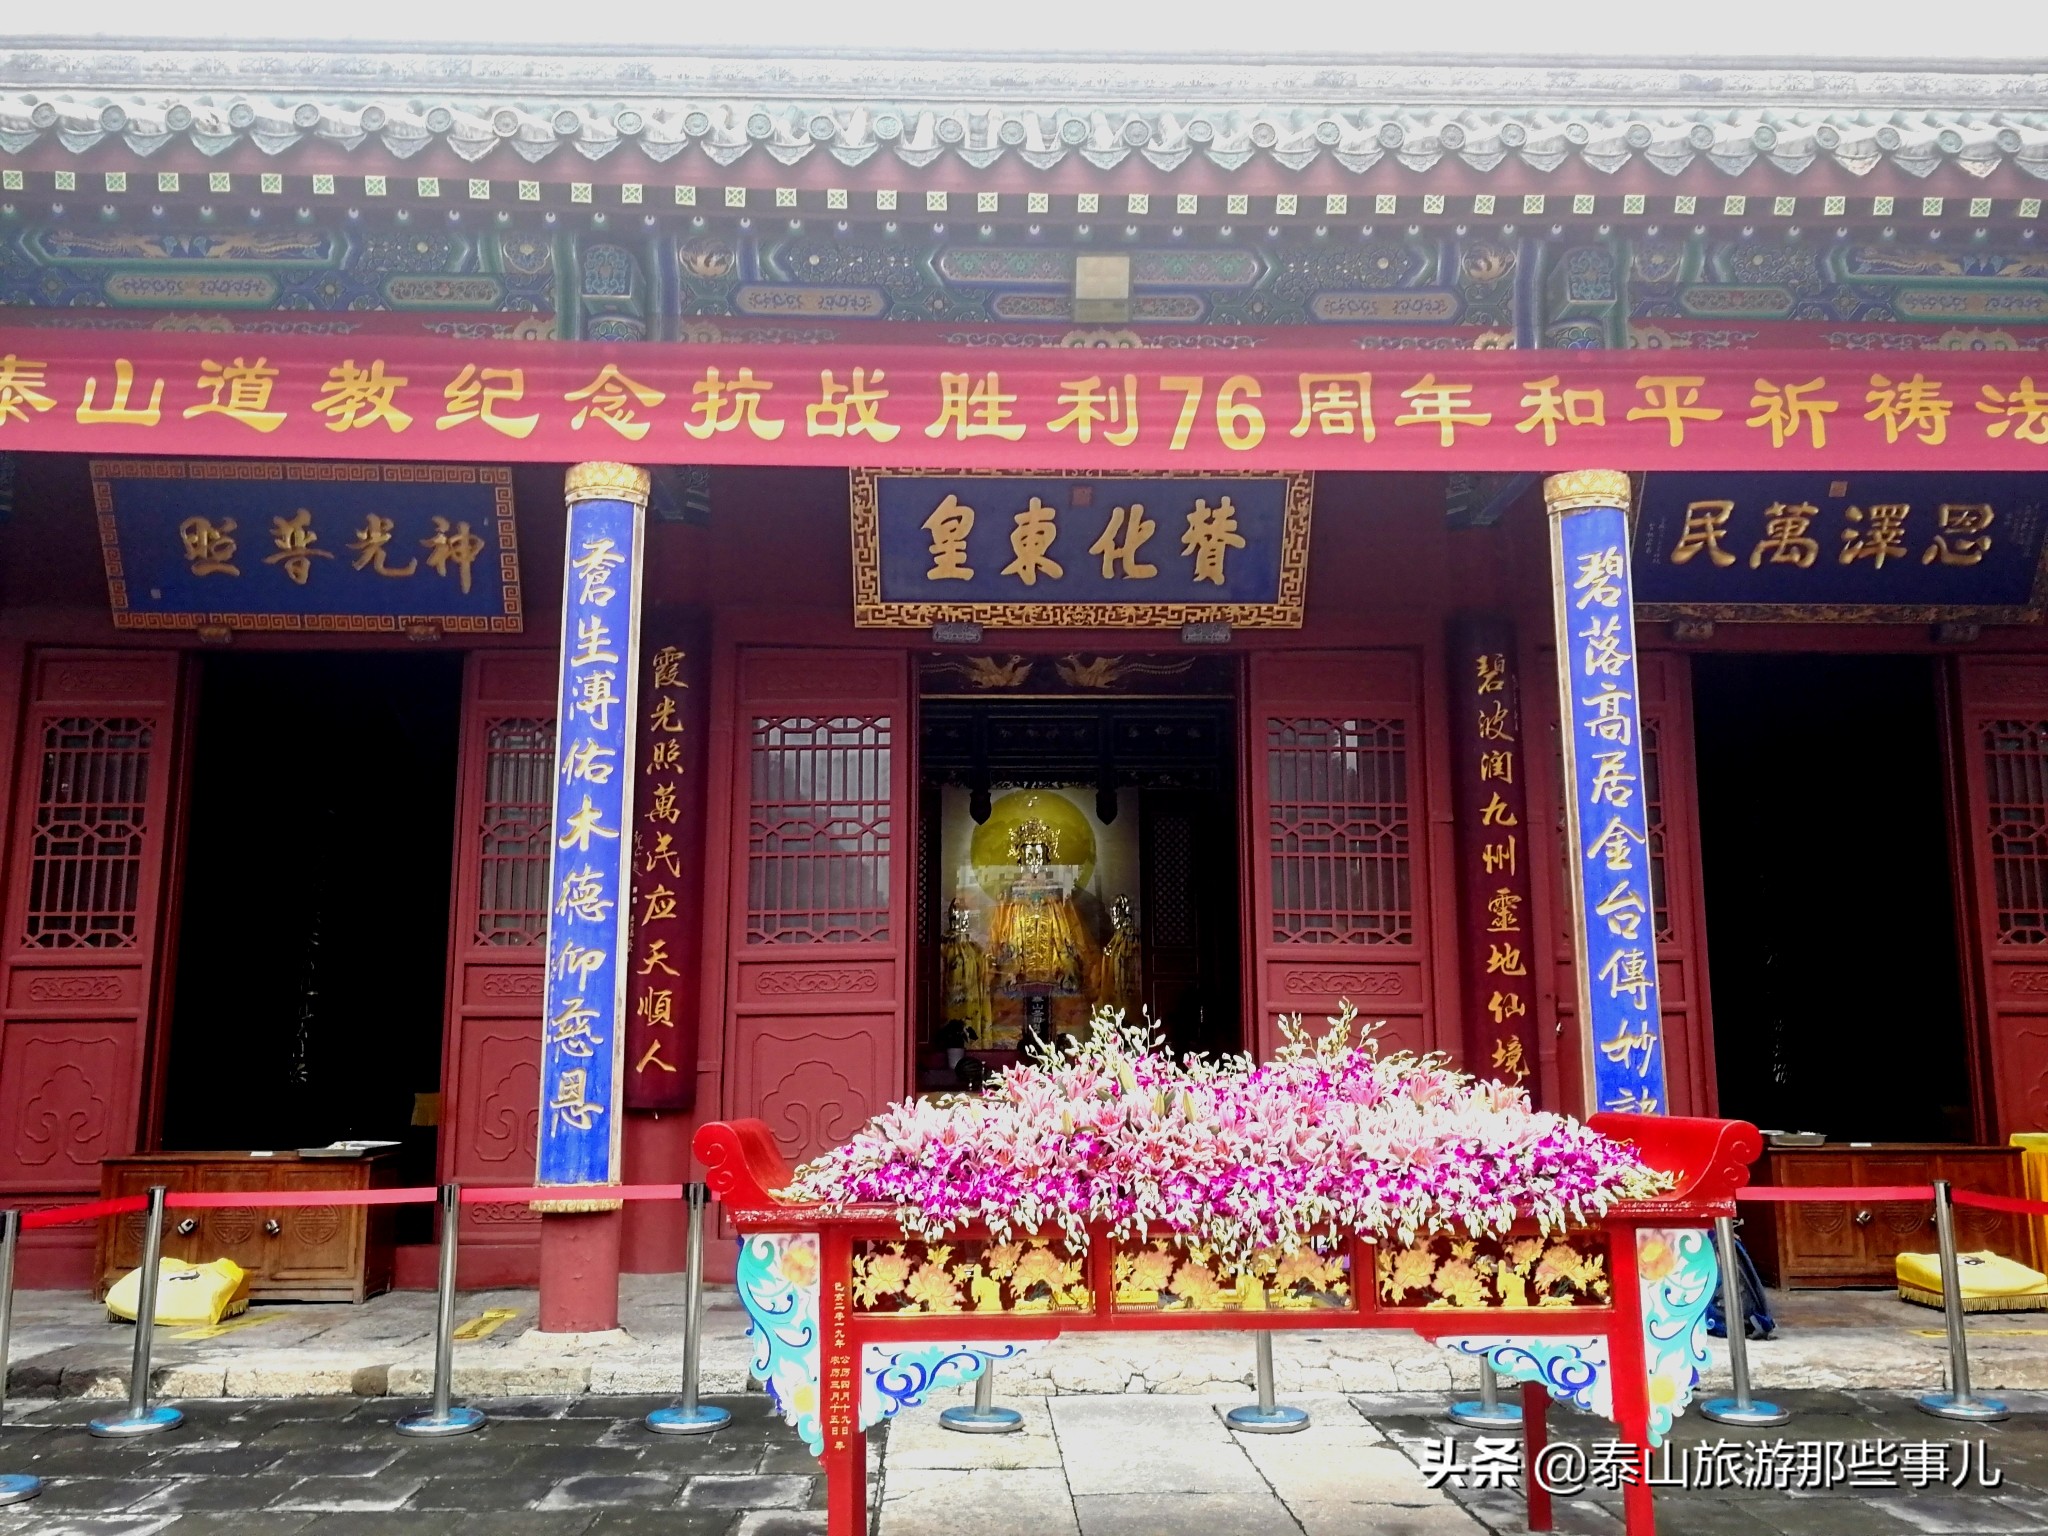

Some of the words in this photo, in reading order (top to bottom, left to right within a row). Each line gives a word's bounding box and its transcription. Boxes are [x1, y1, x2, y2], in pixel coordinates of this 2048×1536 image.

[0, 353, 2048, 450] 泰山道教纪念抗战胜利76周年和平祈祷法
